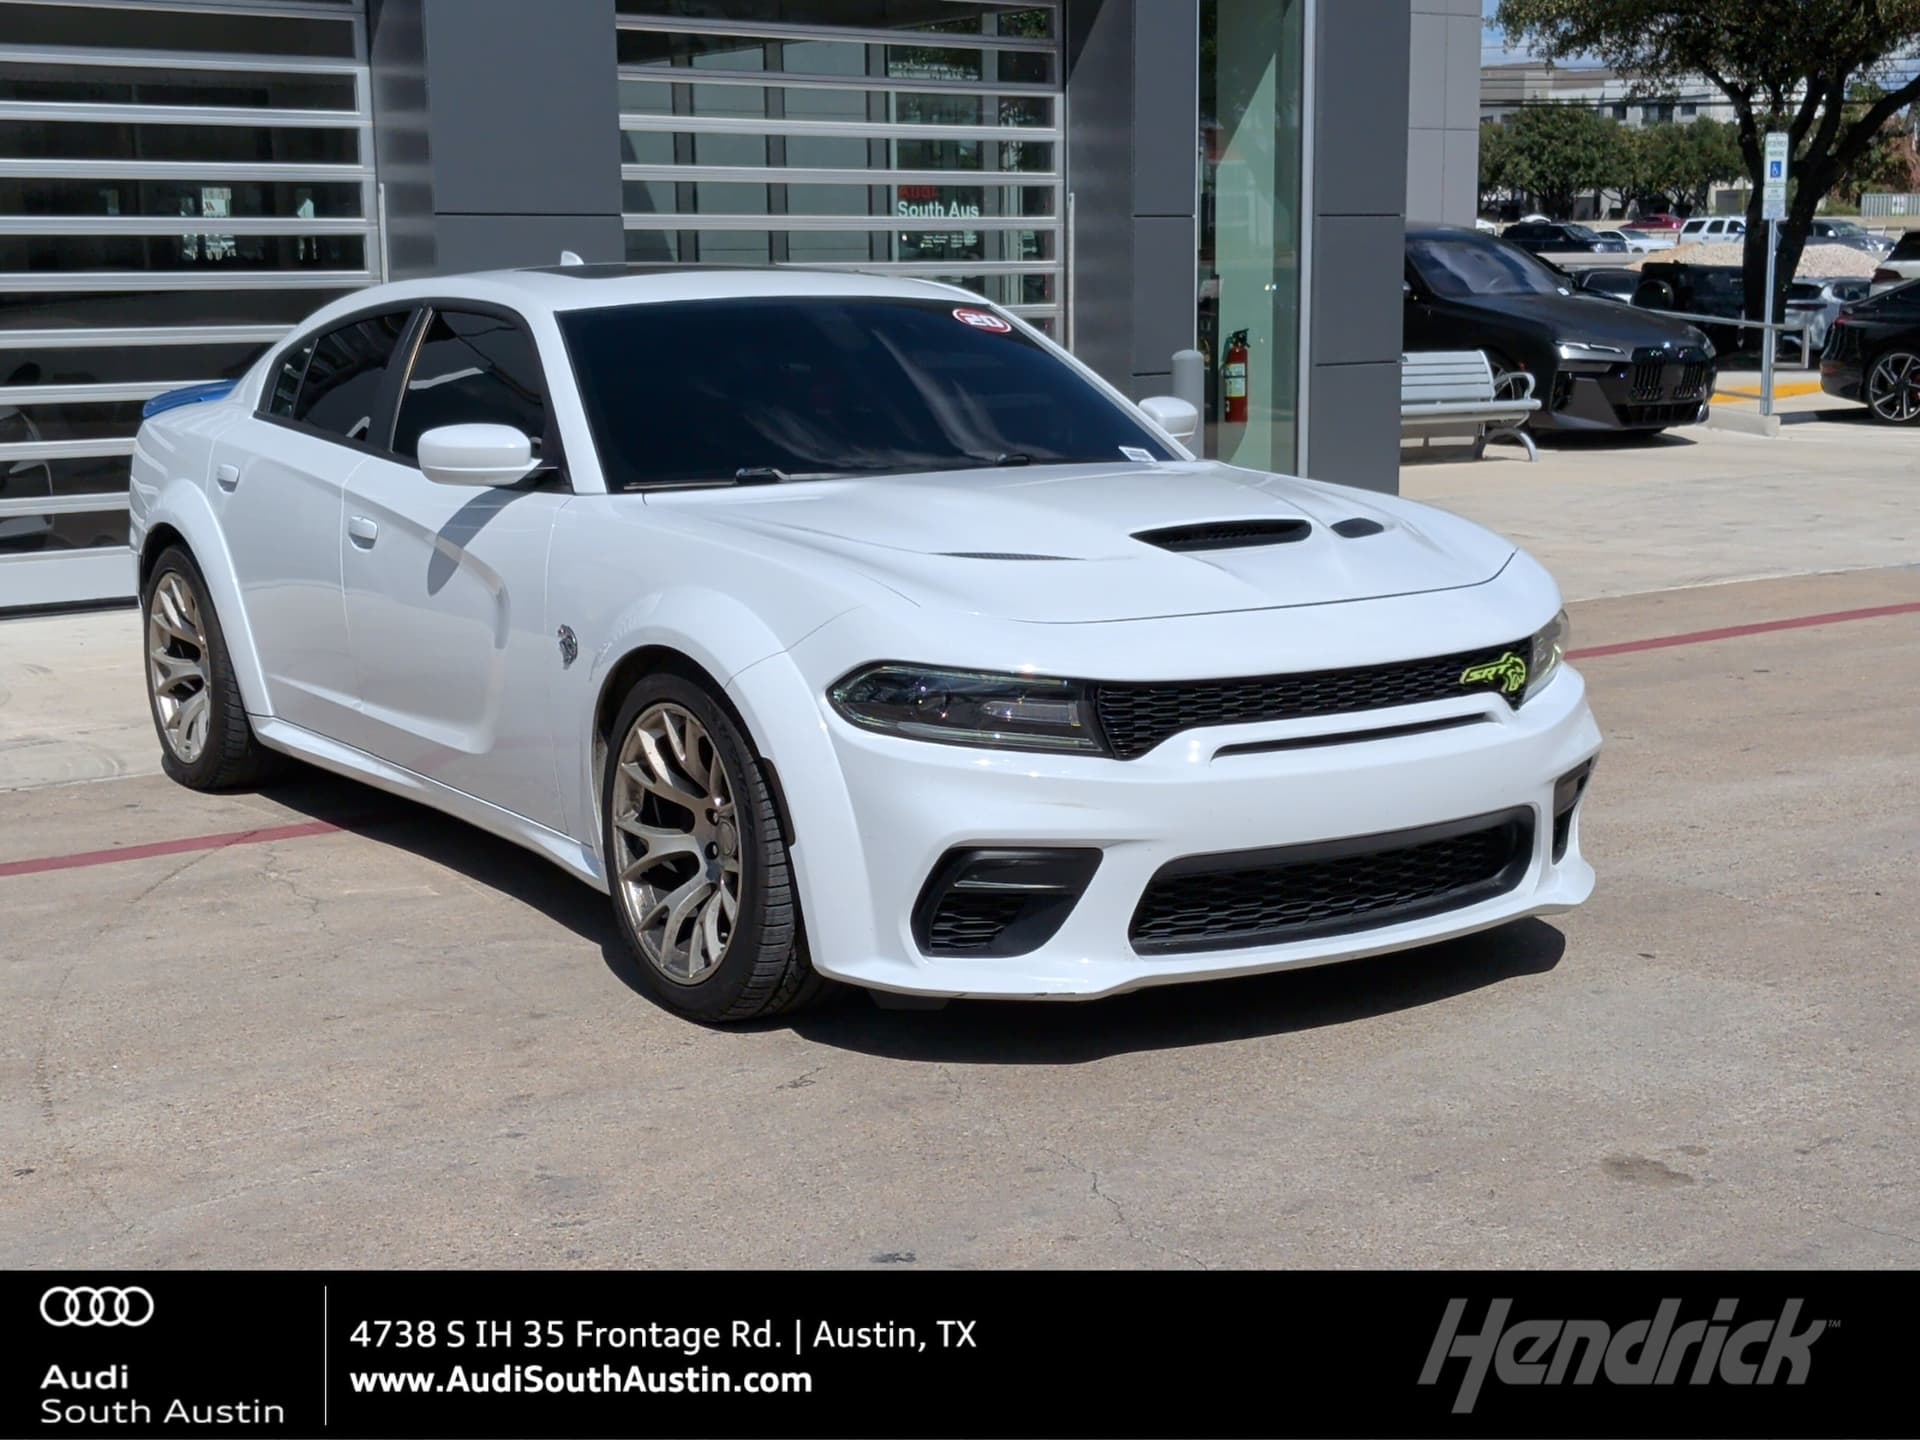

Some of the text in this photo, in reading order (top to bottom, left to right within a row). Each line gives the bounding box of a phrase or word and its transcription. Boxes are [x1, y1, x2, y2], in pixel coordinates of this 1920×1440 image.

[898, 201, 980, 218] South Aus
[1466, 664, 1511, 682] SRT
